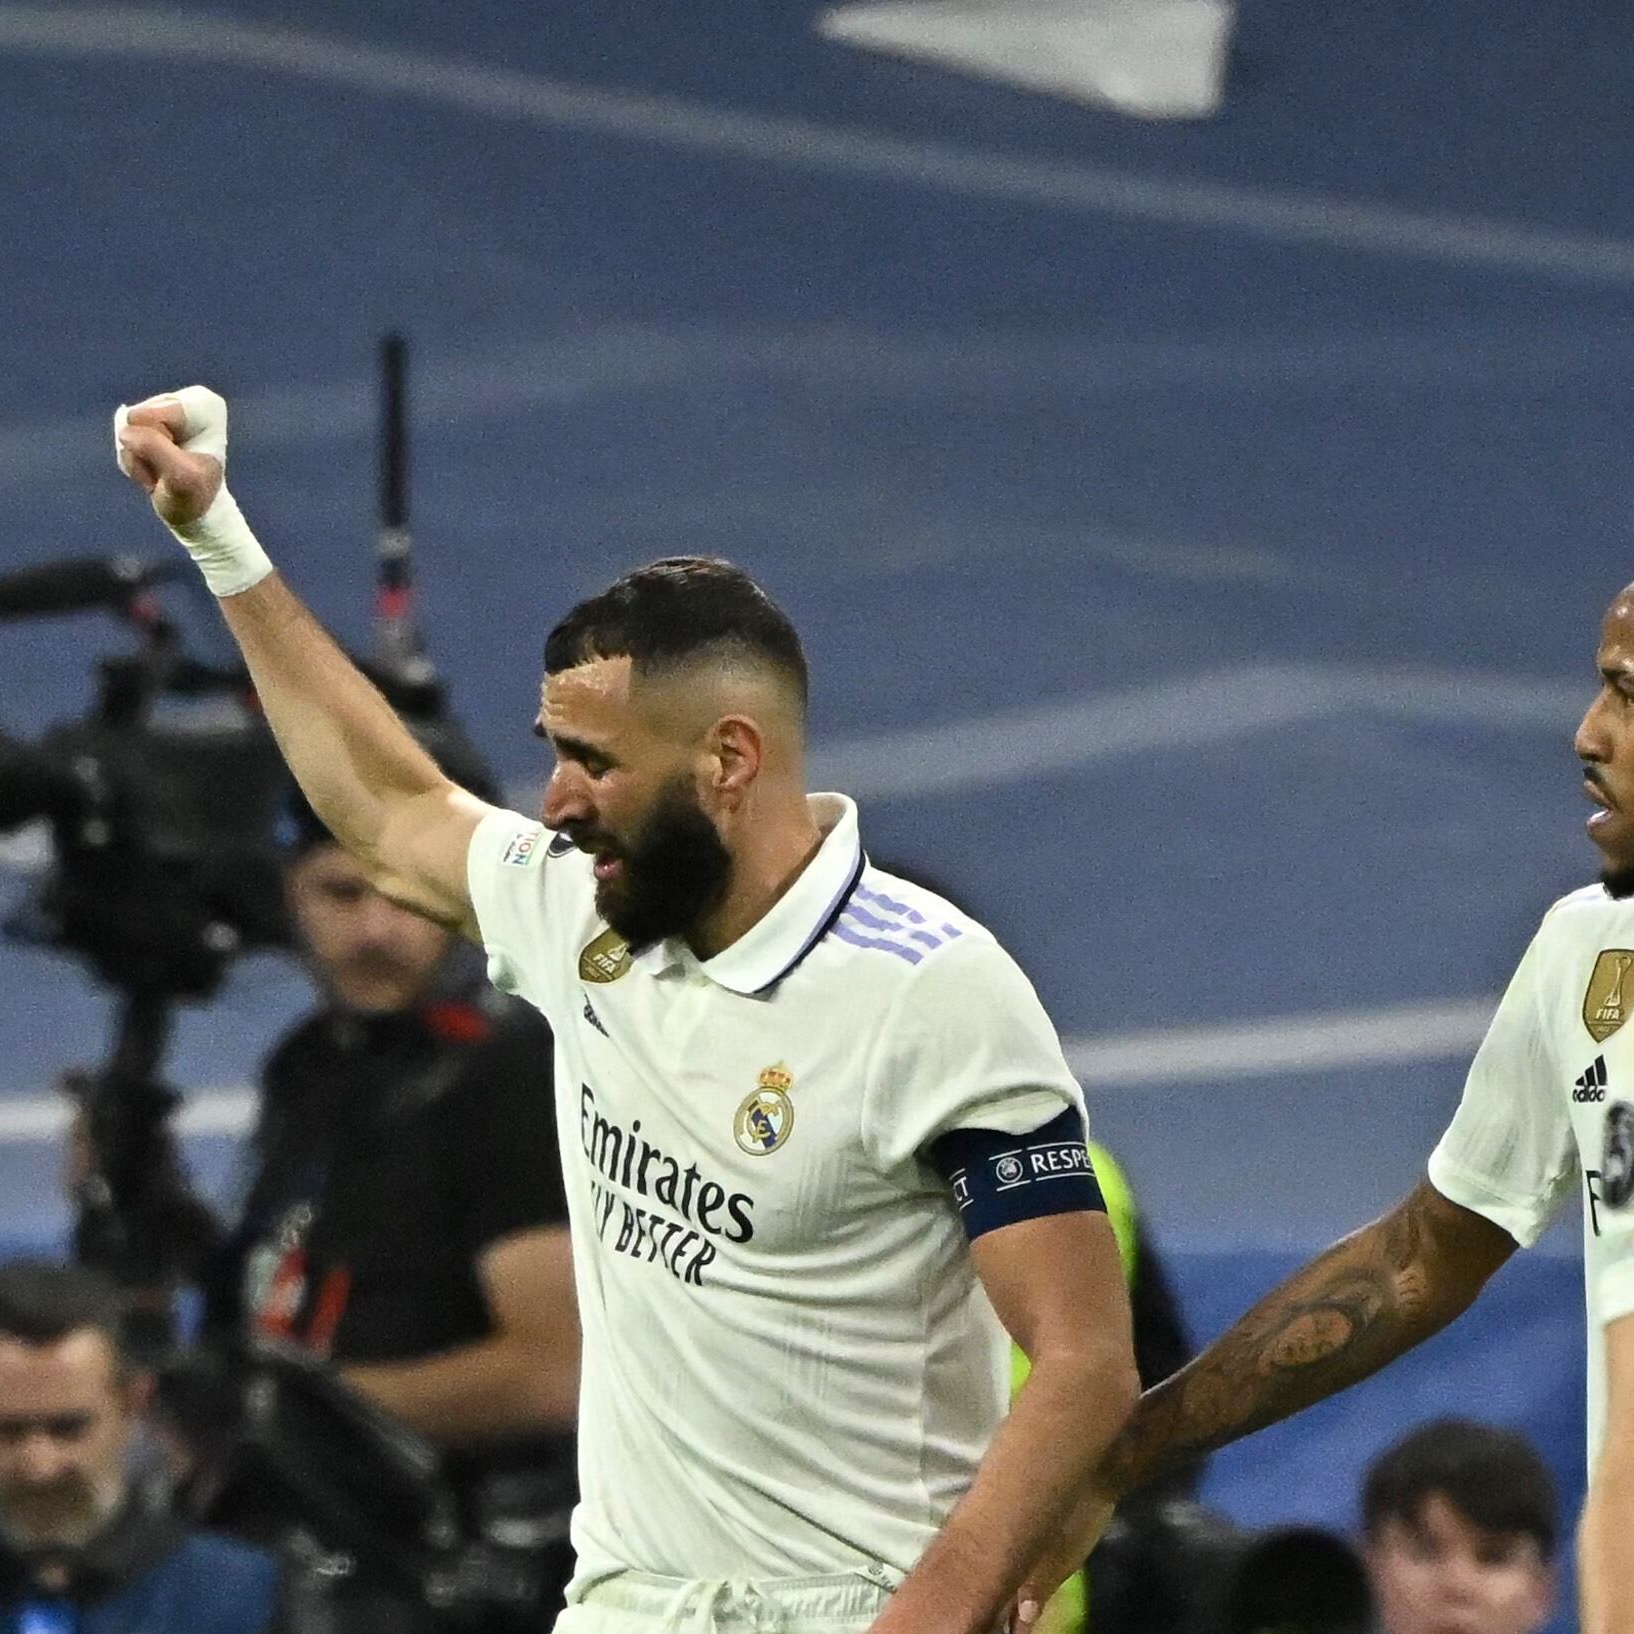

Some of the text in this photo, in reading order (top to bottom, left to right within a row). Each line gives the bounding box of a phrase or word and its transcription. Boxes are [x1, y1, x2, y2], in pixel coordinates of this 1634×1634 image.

[592, 952, 617, 974] FIFA
[1595, 1008, 1621, 1020] FIFA
[581, 1081, 755, 1244] Emirates
[615, 1201, 717, 1287] BETTER
